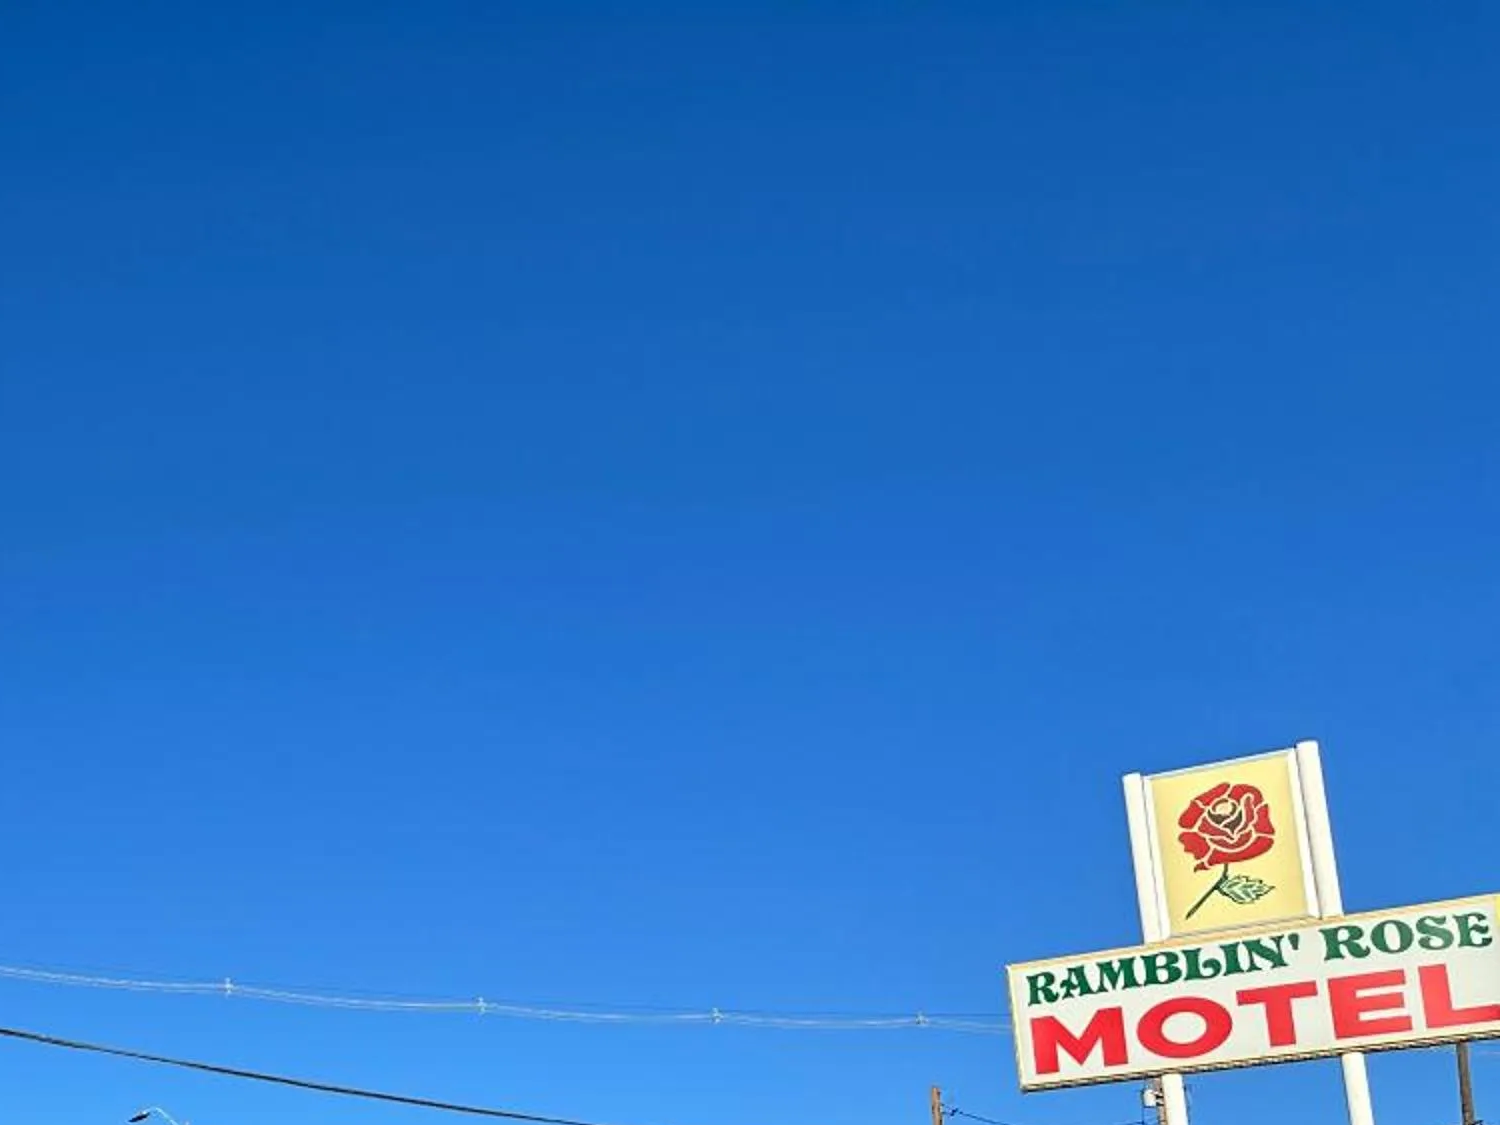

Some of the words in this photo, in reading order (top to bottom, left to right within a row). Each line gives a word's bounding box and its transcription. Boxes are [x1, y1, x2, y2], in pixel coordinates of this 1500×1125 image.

[1027, 933, 1300, 1006] RAMBLIN'
[1319, 911, 1493, 960] ROSE
[1029, 963, 1500, 1075] MOTEL
